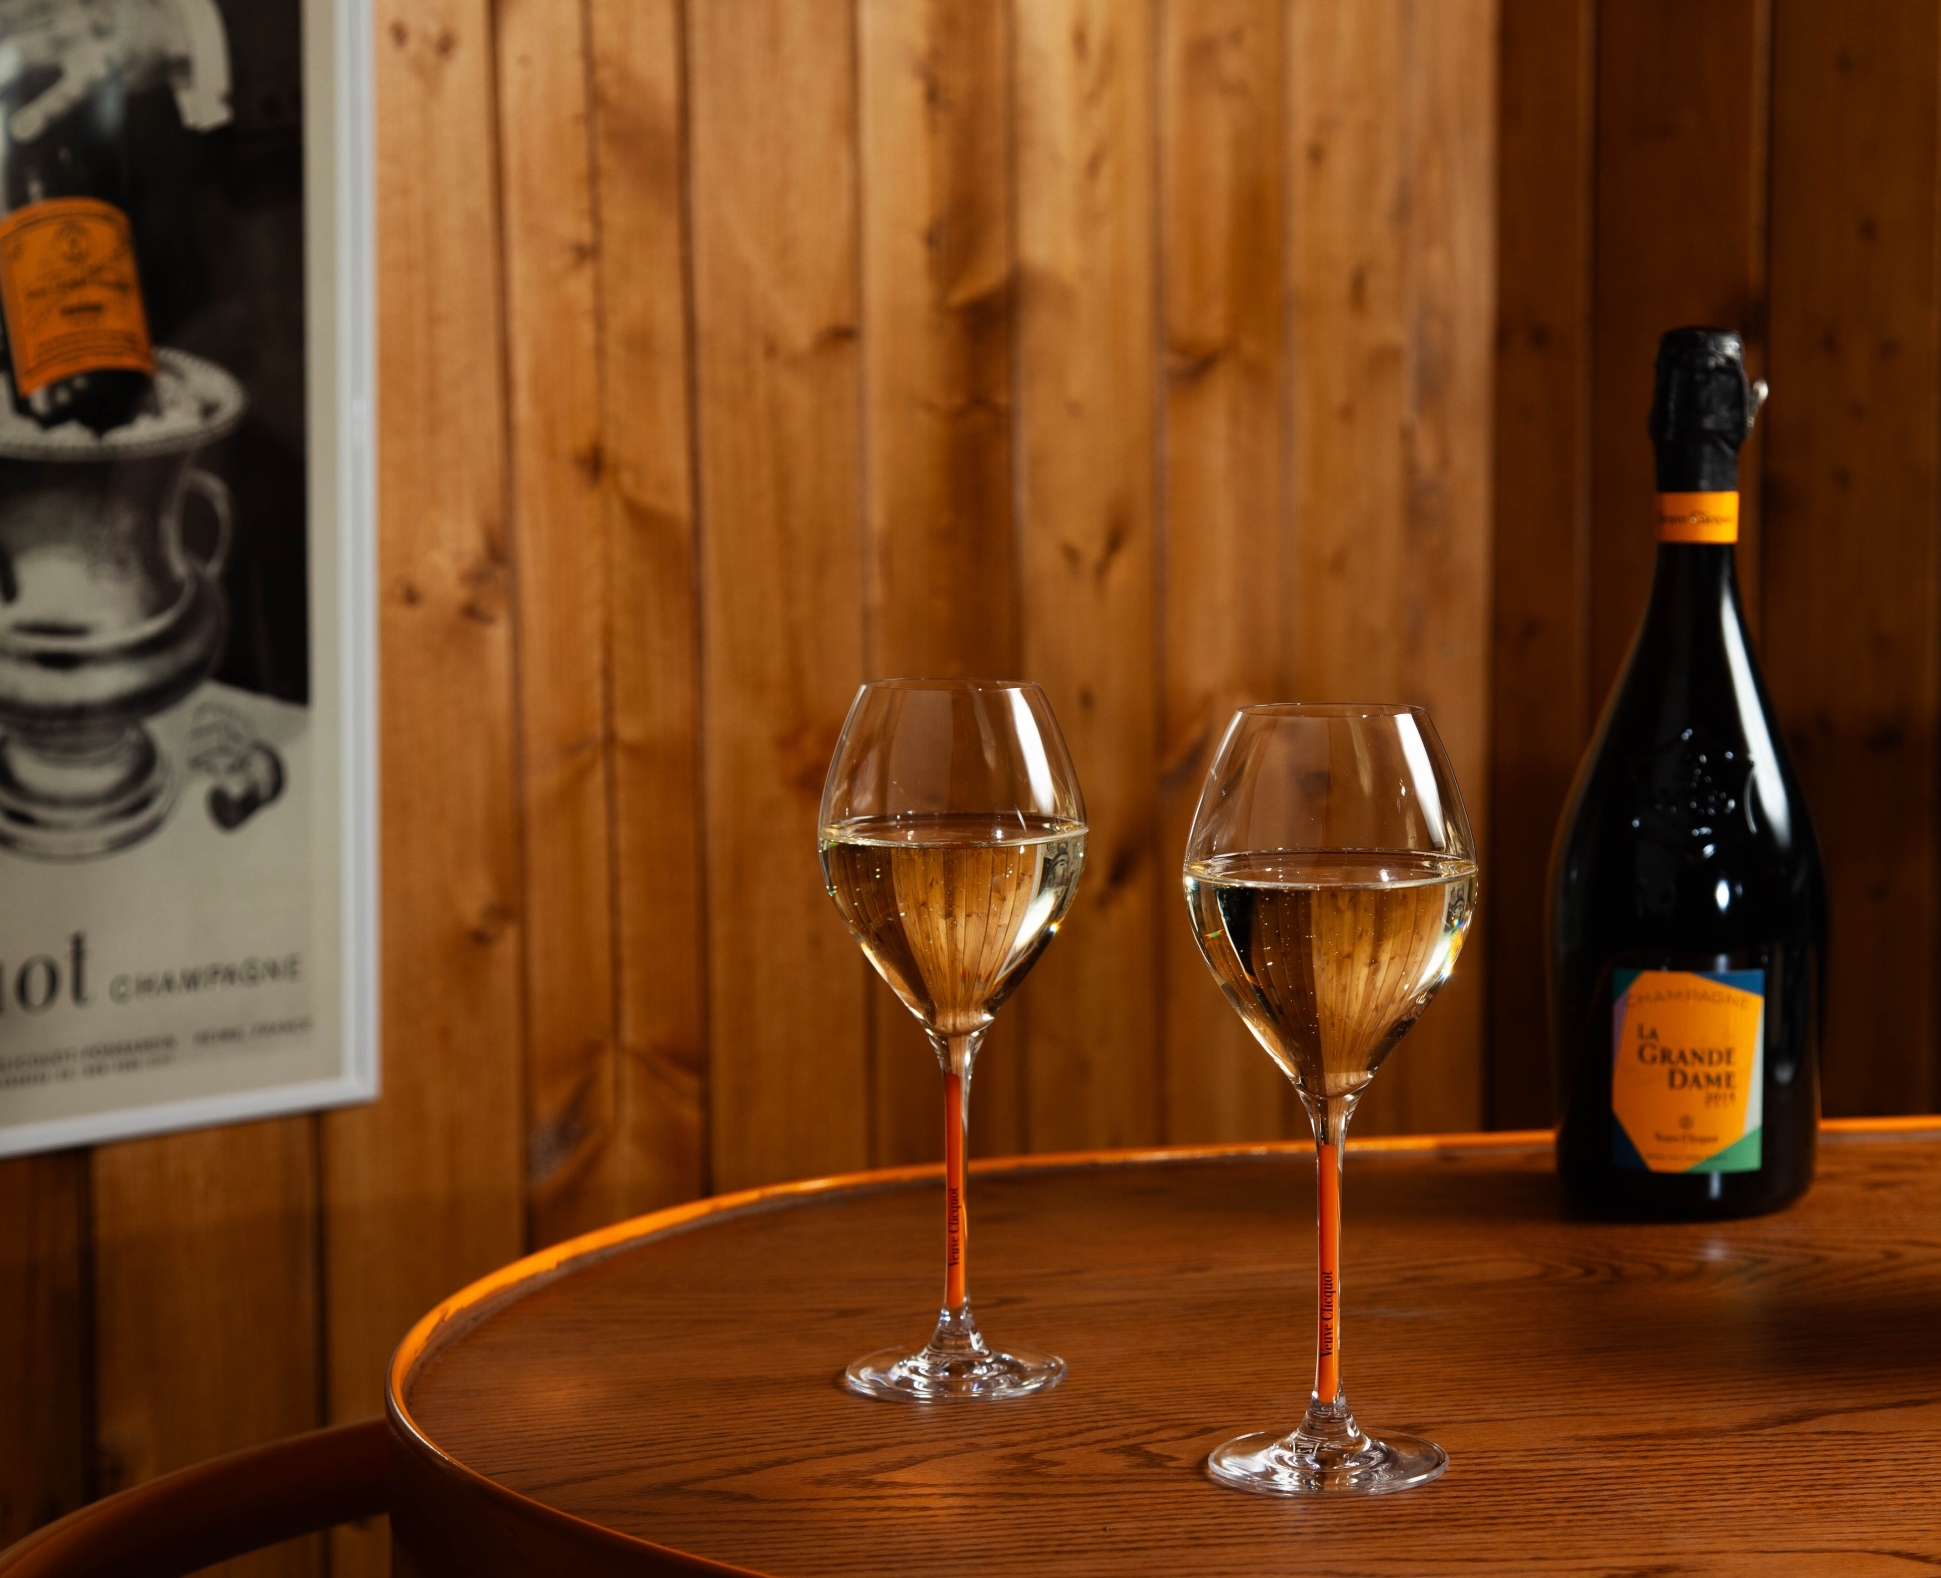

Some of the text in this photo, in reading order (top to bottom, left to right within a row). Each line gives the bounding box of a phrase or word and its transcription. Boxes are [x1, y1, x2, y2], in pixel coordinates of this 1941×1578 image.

[0, 929, 301, 1017] ot CHAMPAGNE
[1624, 989, 1750, 1010] CHAMPAGNE
[1637, 1022, 1659, 1040] LA
[1637, 1042, 1736, 1067] GRANDE
[1668, 1067, 1736, 1090] DAME
[947, 1188, 962, 1267] Veuve Clicquot
[1319, 1271, 1336, 1358] Veuve Clicquot
